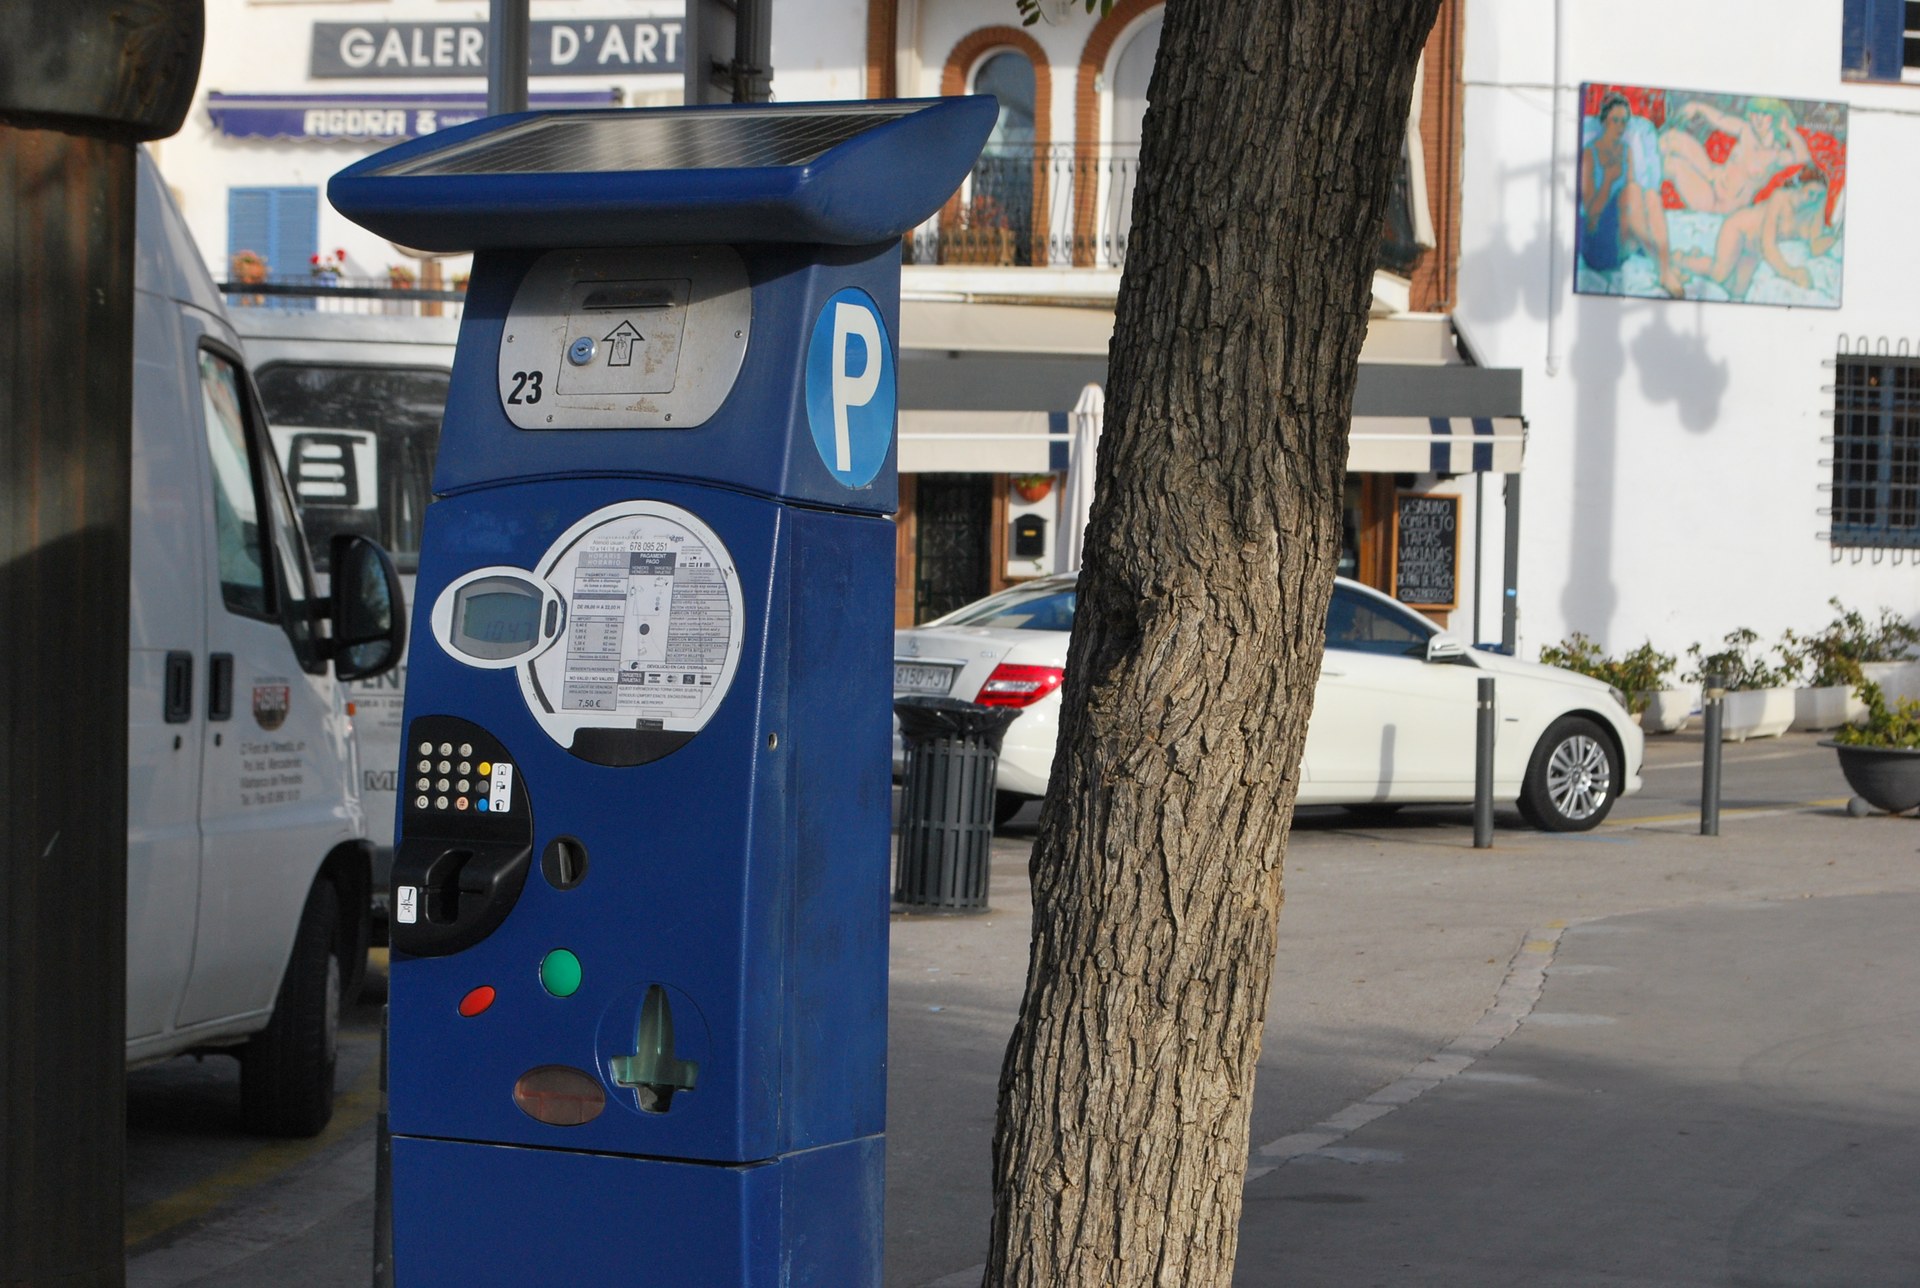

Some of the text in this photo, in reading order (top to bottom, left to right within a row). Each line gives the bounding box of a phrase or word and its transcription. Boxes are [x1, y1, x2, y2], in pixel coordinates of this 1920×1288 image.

[340, 23, 682, 67] GALER D'ART
[303, 109, 406, 136] AGORA
[507, 370, 544, 405] 23
[831, 301, 882, 473] P
[629, 542, 668, 551] 678 095 251
[1404, 530, 1441, 547] TAPAS
[578, 699, 601, 708] 7,50 €
